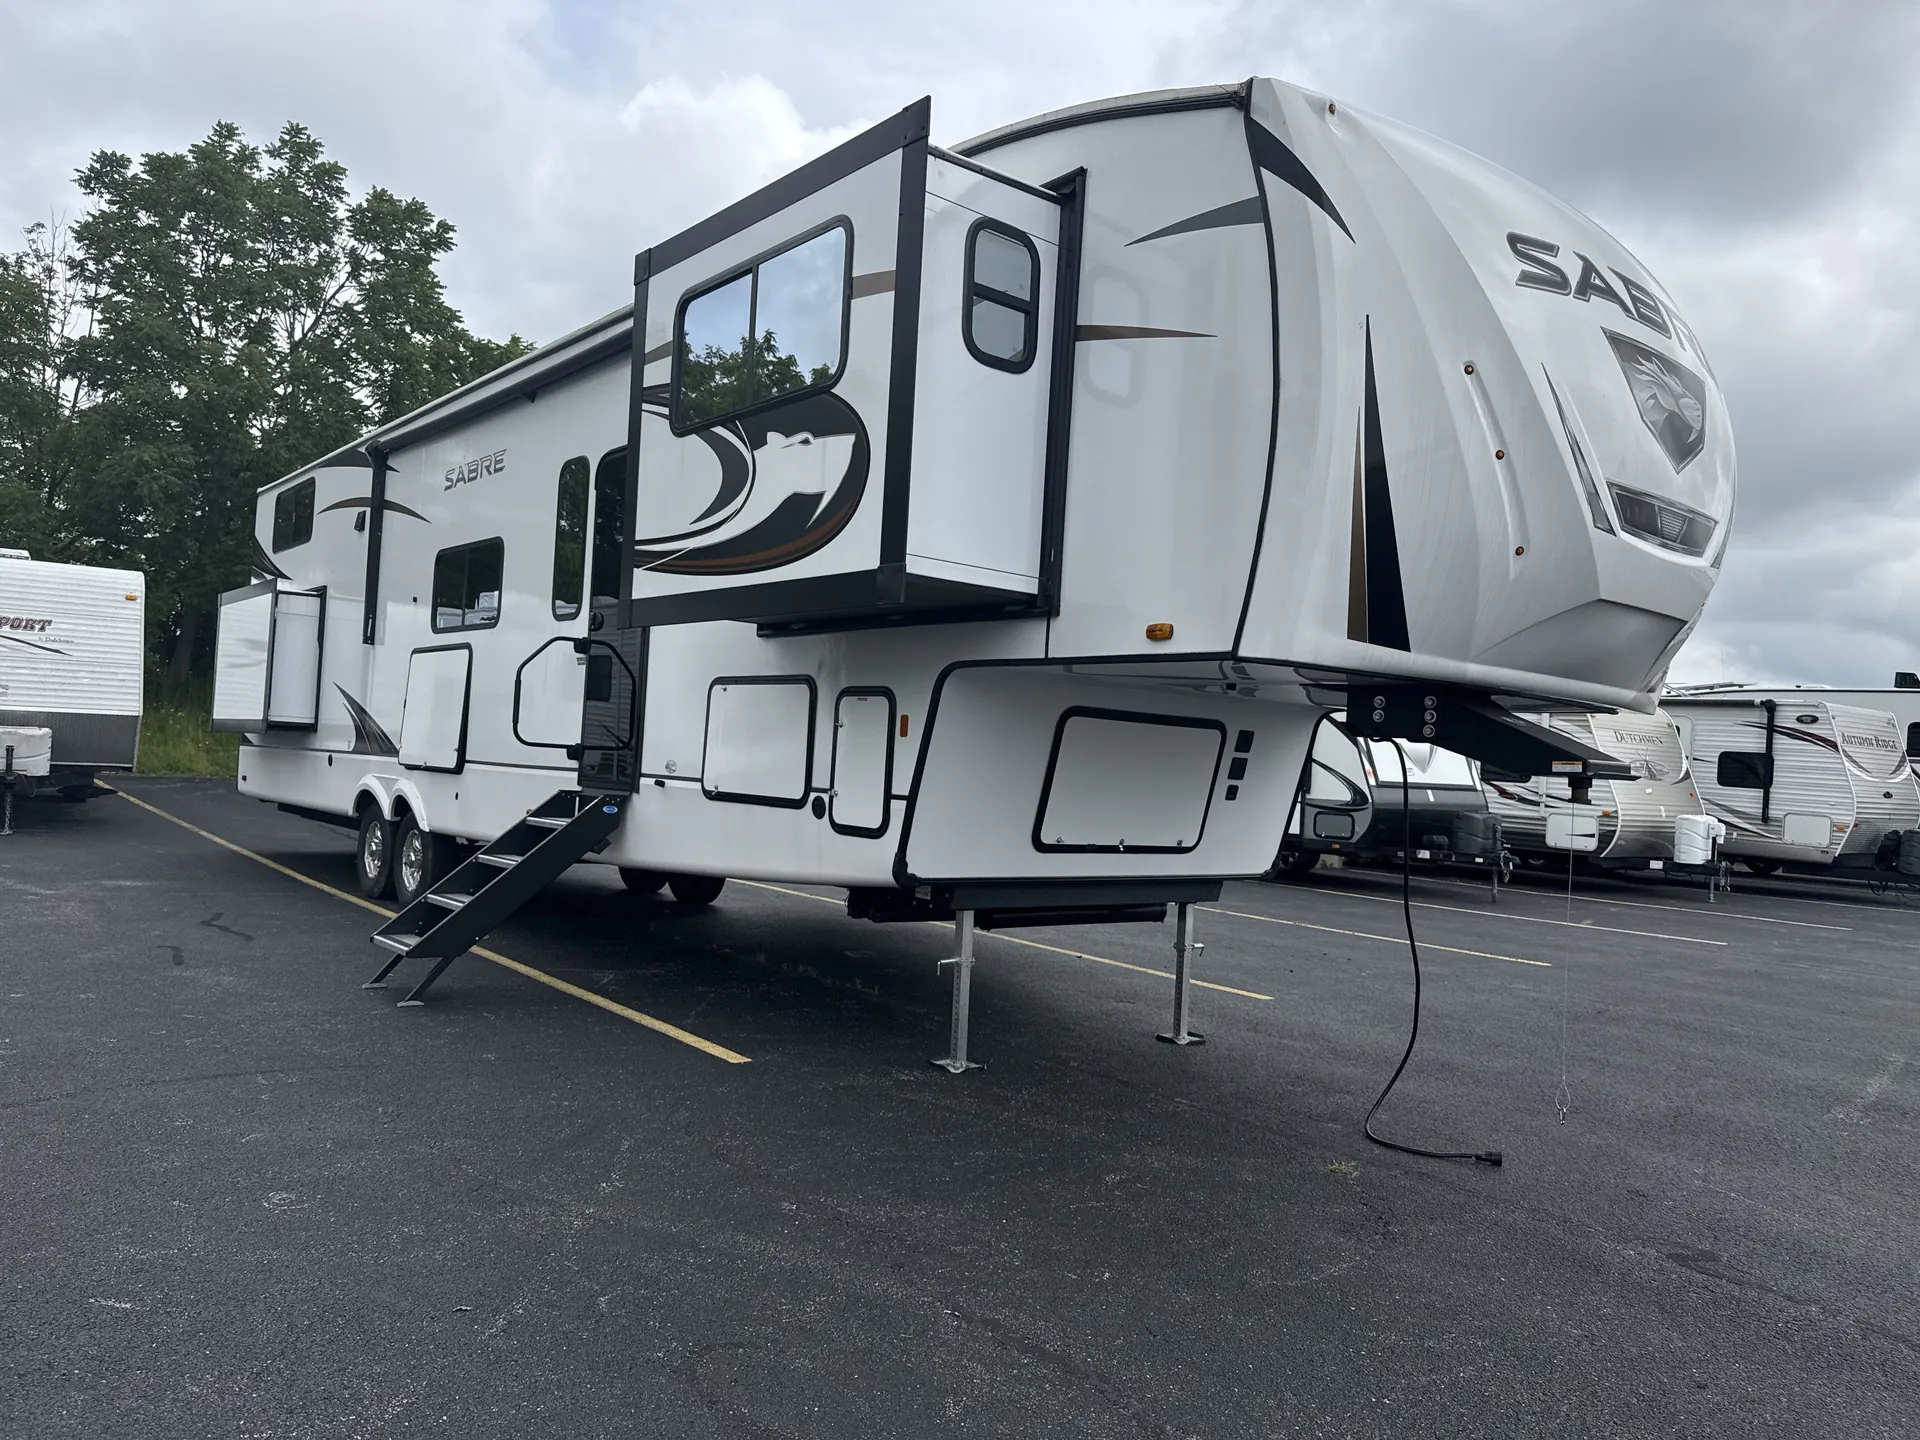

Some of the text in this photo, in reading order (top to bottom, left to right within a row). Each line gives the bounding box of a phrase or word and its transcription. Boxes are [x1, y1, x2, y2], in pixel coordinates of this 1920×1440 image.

[1506, 231, 1716, 382] SABR
[443, 448, 507, 492] SABRE
[1613, 730, 1664, 746] DUTCHMEN
[1841, 731, 1898, 750] AUTUMN RIDGE
